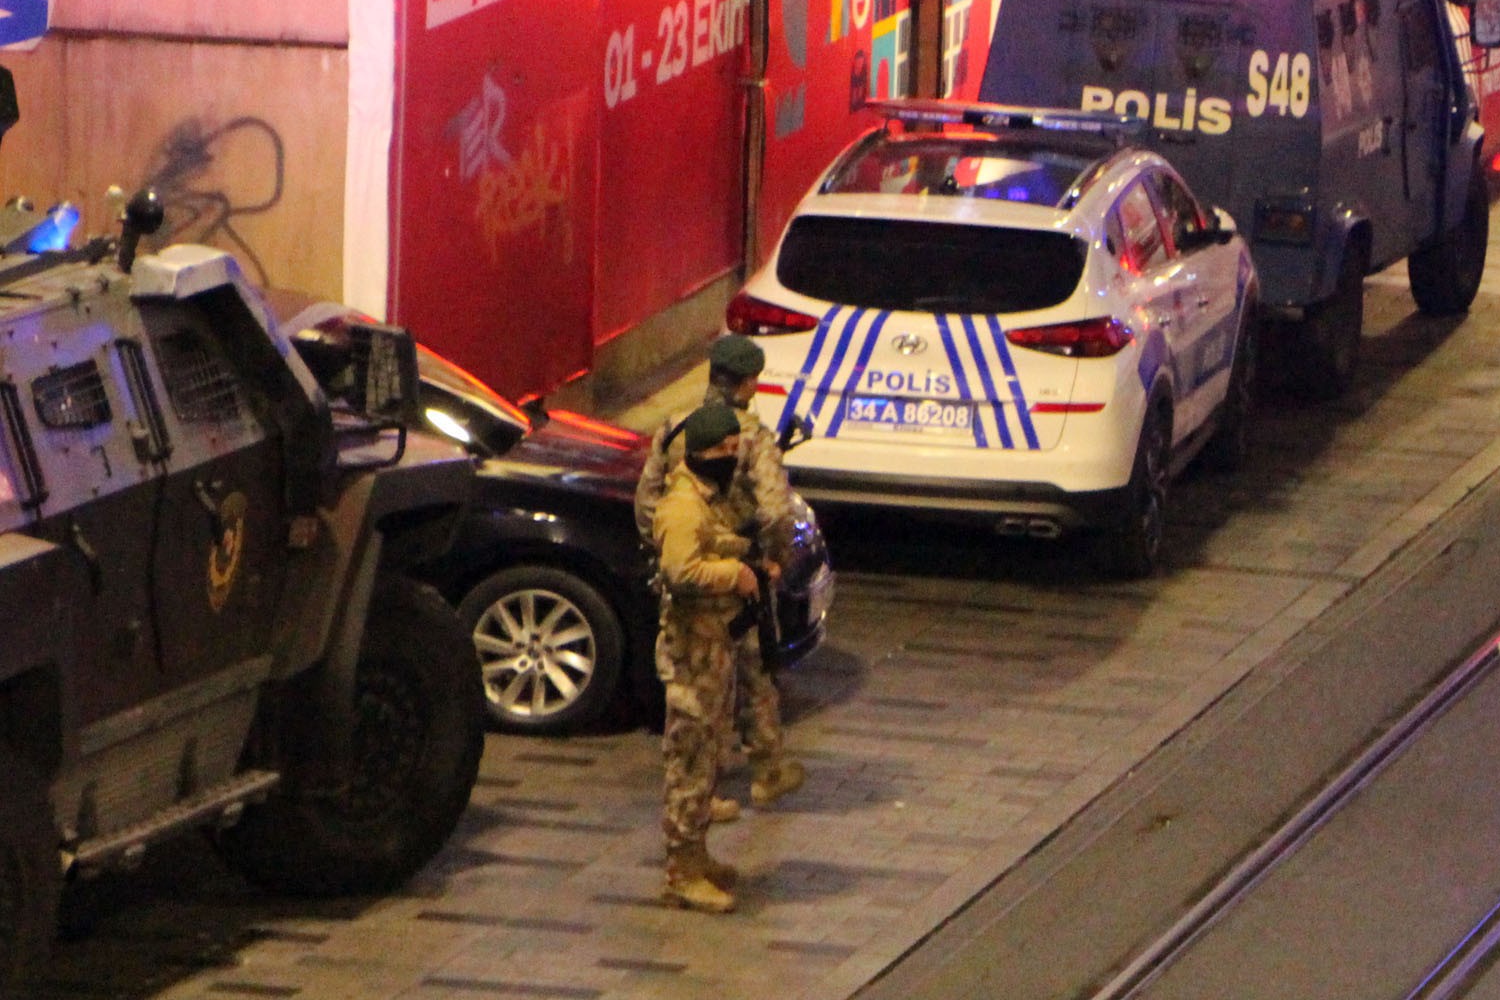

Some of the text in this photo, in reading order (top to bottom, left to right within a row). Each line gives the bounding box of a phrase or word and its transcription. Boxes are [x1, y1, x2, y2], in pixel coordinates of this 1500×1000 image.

[604, 24, 637, 109] 01
[656, 0, 689, 85] 23
[1246, 49, 1311, 119] S48
[1080, 85, 1233, 135] POLİS
[867, 368, 951, 395] POLİS
[850, 398, 878, 422] 34
[880, 400, 899, 423] A
